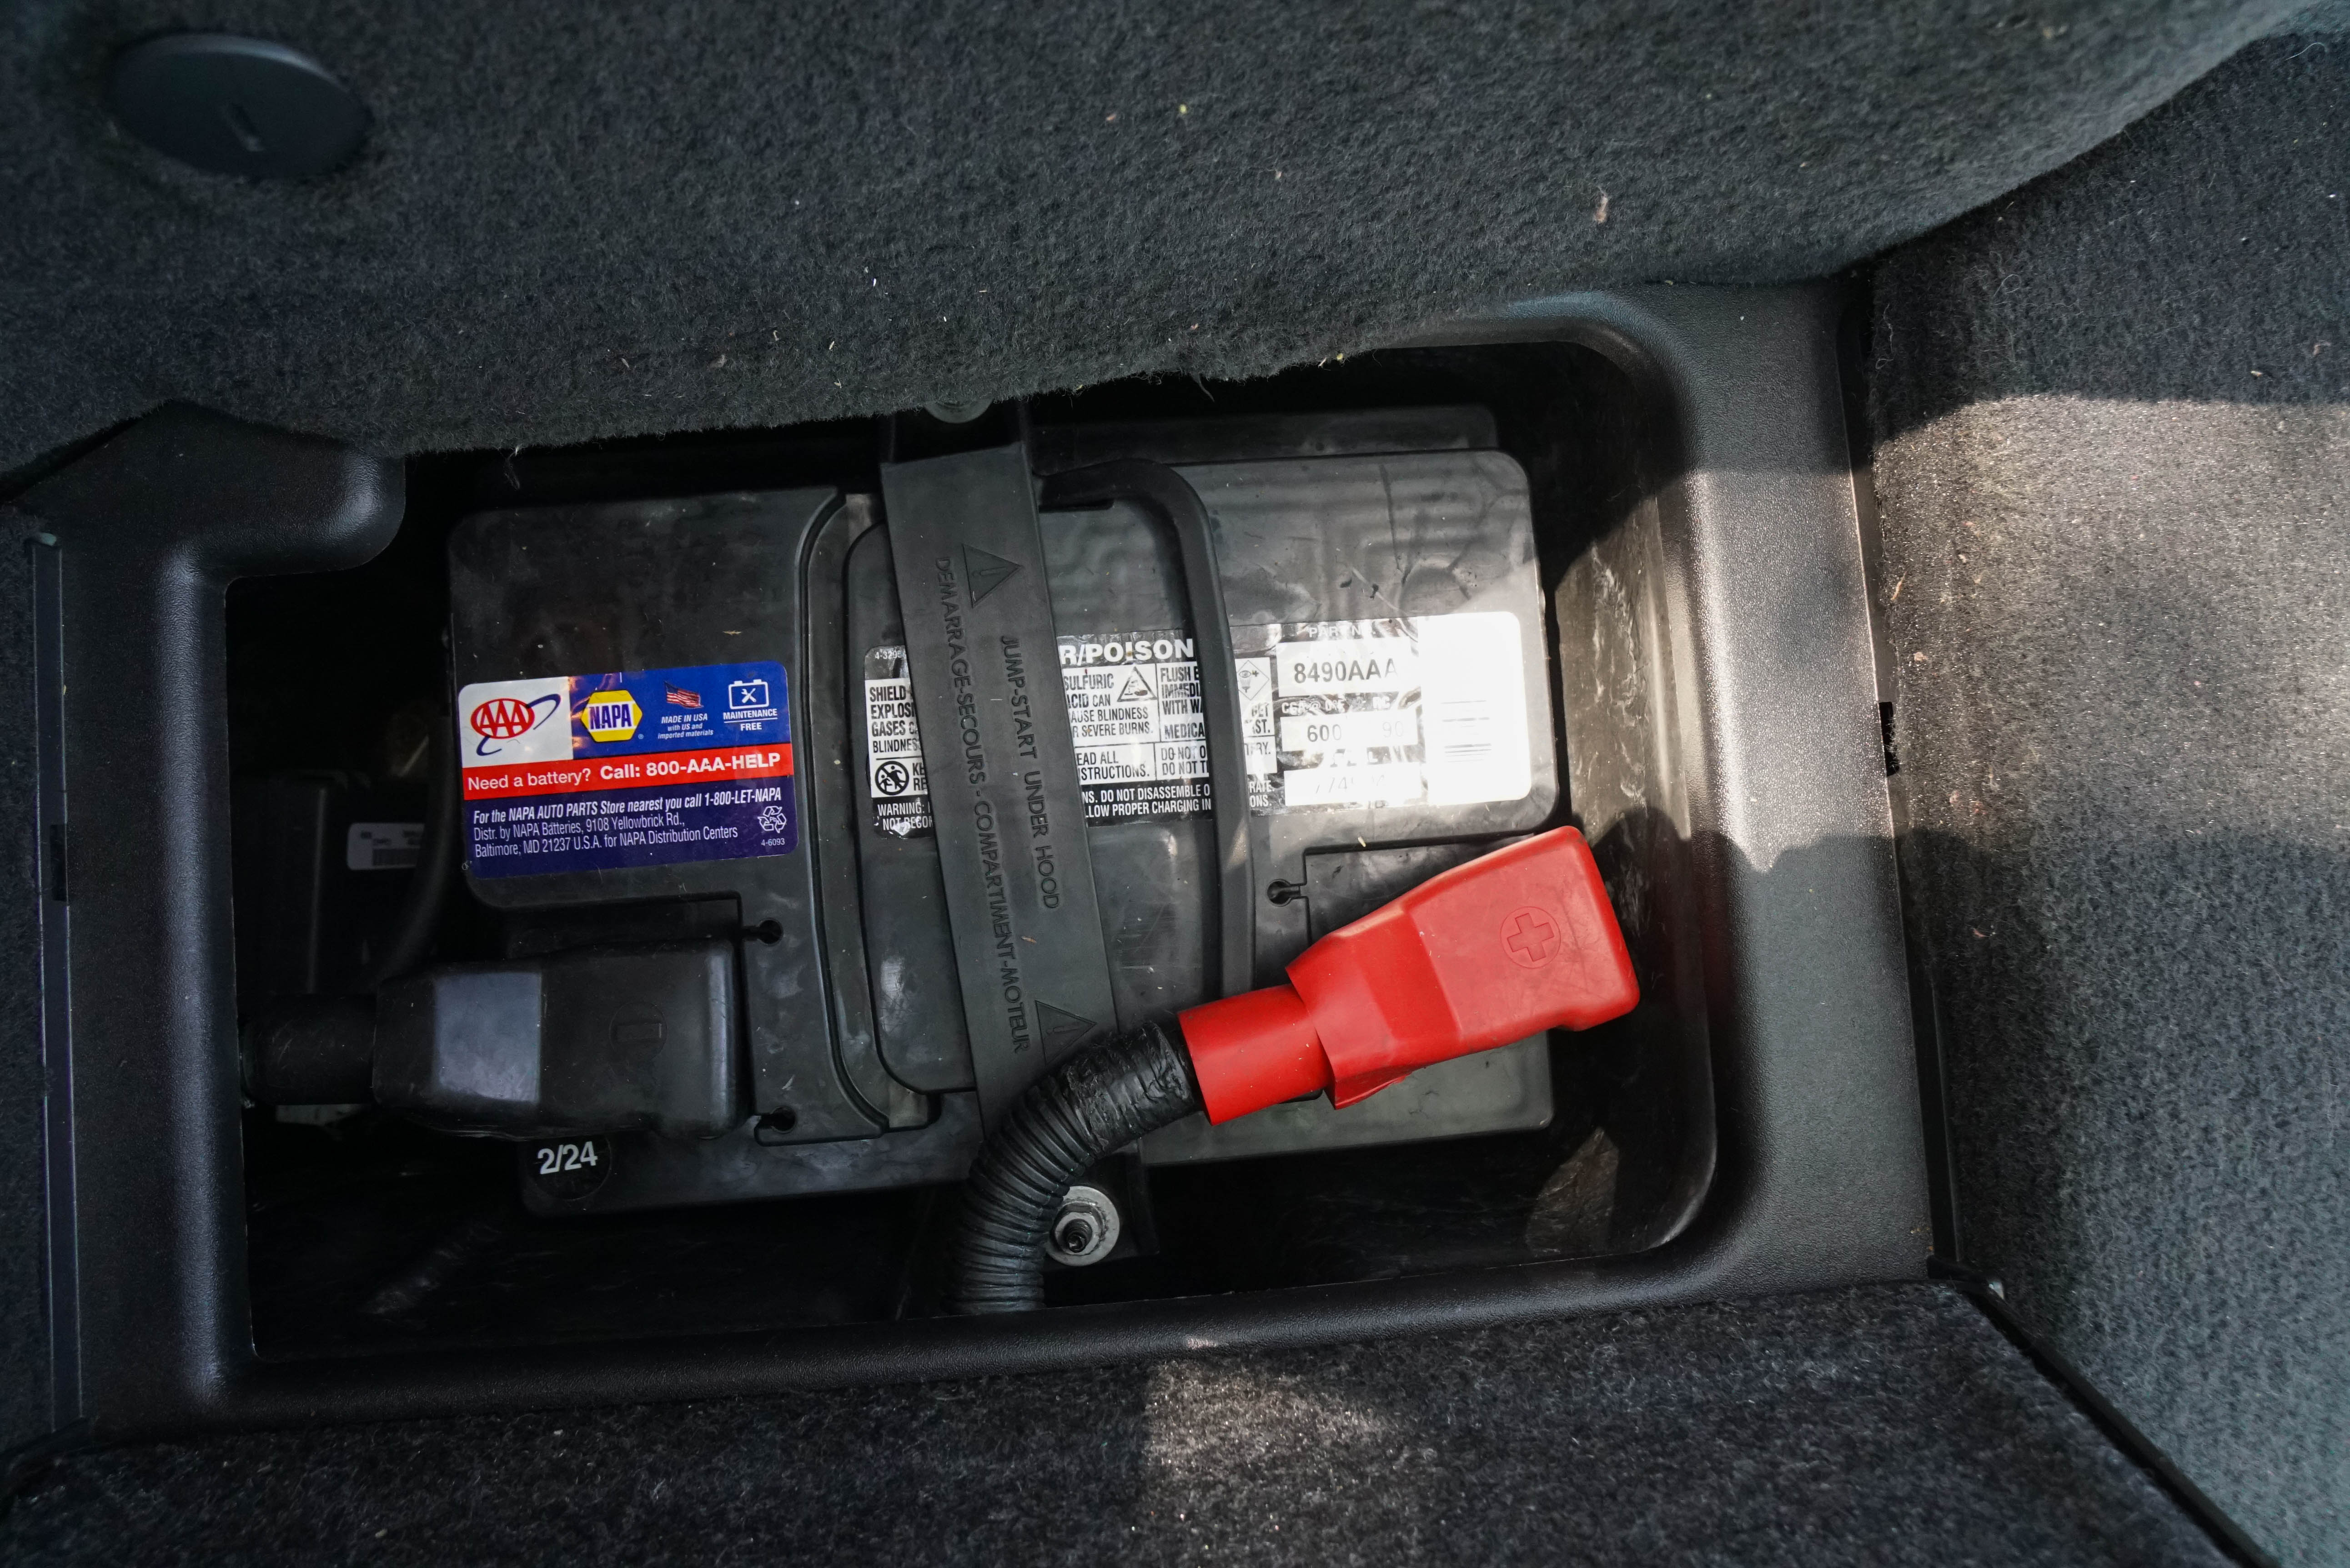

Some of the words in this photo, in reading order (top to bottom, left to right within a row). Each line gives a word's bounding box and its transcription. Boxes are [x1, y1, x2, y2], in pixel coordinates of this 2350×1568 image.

[1309, 625, 1348, 637] PAR
[1059, 638, 1194, 666] R/POISON
[1160, 666, 1191, 682] FLUSH
[1294, 658, 1398, 683] 8490AAA
[1064, 673, 1114, 691] SULFURIC
[869, 685, 906, 702] SHIELD
[1002, 636, 1038, 759] JUMP-START
[1092, 694, 1111, 707] CAN
[723, 709, 778, 720] MAINTENANCE
[1070, 709, 1095, 724] AUSE
[1098, 706, 1149, 722] BLINDNESS
[1162, 699, 1188, 715] WITH
[479, 699, 529, 738] AAA
[589, 704, 632, 729] NAPA
[662, 715, 682, 724] MADE
[684, 714, 693, 723] IN
[694, 713, 708, 721] USA
[658, 731, 684, 740] imported
[685, 729, 713, 737] materials
[740, 722, 762, 731] FREE
[872, 720, 906, 737] GASES
[1082, 724, 1116, 737] SEVERE
[1119, 721, 1154, 735] BURNS.
[1307, 724, 1341, 742] 600
[1382, 721, 1404, 738] 90
[873, 737, 921, 753] BLINDNES
[1161, 747, 1175, 760] DO
[1178, 746, 1197, 759] NOT
[1100, 750, 1119, 764] ALL
[468, 775, 508, 790] Need
[514, 778, 523, 787] a
[528, 768, 591, 786] battery?
[600, 764, 640, 780] Call:
[646, 753, 780, 776] 800-AAA-HELP
[1162, 762, 1175, 776] DO
[1179, 761, 1198, 774] NOT
[1101, 790, 1114, 803] DO
[1116, 788, 1135, 801] NOT
[1138, 784, 1201, 800] DISASSEMBLE
[473, 810, 489, 824] For
[492, 809, 506, 822] the
[509, 806, 535, 821] NAPA
[537, 804, 563, 819] AUTO
[566, 801, 598, 817] PARTS
[601, 800, 625, 814] Store
[628, 797, 663, 813] nearest
[665, 796, 682, 812] you
[684, 793, 702, 808] call
[705, 787, 781, 806] 1-800-LET-NAPA
[878, 802, 924, 816] WARNING:
[1025, 771, 1049, 838] UNDER
[1085, 805, 1110, 818] LOW
[1113, 802, 1149, 816] PROPER
[1152, 799, 1199, 814] CHARGING
[474, 826, 497, 841] Distr.
[500, 825, 511, 841] by
[513, 823, 539, 838] NAPA
[542, 821, 584, 836] Batteries,
[586, 817, 609, 832] 9108
[612, 813, 664, 829] Yellowbrick
[667, 812, 685, 826] Rd.,
[475, 843, 521, 858] Baltimore,
[524, 839, 539, 854] MD
[542, 837, 571, 853] 21237
[574, 835, 602, 850] U.S.A.
[604, 834, 618, 848] for
[620, 832, 646, 846] NAPA
[649, 829, 701, 844] Distribution
[703, 825, 738, 840] Centers
[761, 837, 785, 847] 4-6093
[1034, 845, 1060, 909] HOOD
[537, 1141, 598, 1175] 2/24
